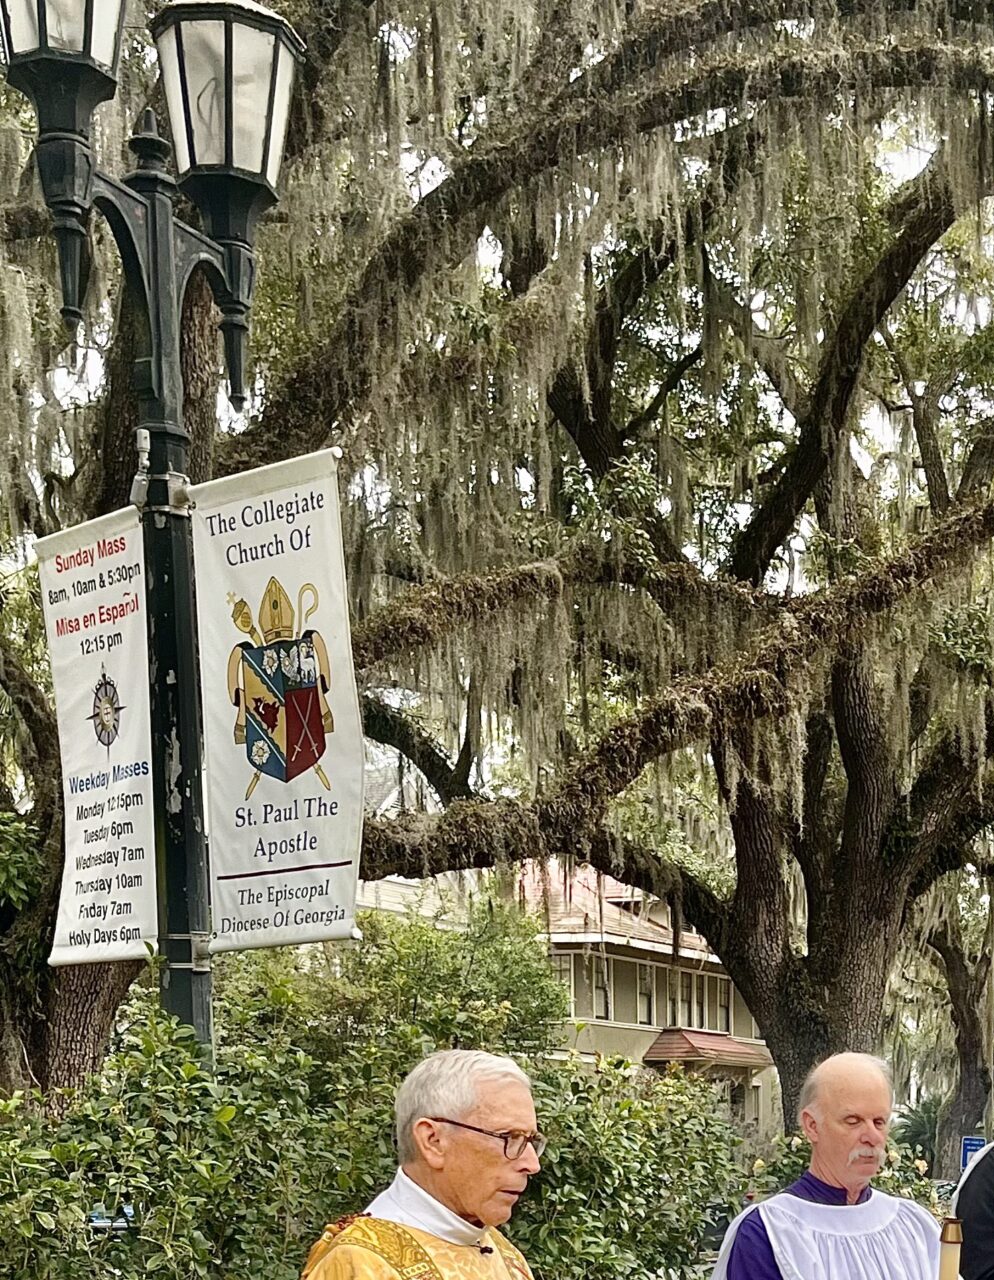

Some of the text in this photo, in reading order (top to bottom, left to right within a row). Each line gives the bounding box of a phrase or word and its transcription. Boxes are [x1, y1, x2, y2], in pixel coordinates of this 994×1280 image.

[206, 491, 324, 536] The Collegiate
[55, 536, 126, 573] Sunday Mass
[226, 525, 311, 566] Church Of
[48, 587, 70, 605] 8am,
[72, 578, 97, 597] 10am
[99, 572, 106, 588] &
[56, 592, 139, 637] Misa en Español
[80, 632, 123, 655] 12:15 pm
[69, 761, 149, 794] Weekday Masses
[76, 801, 105, 821] Monday
[235, 796, 338, 828] St. Paul The
[83, 821, 134, 844] Tuesday 6pm
[253, 830, 318, 862] Apostle
[75, 846, 145, 871] Wednesday 7am
[75, 873, 143, 896] Thursday 10am
[237, 879, 330, 907] The Episcopal
[78, 900, 132, 921] Friday 7am
[221, 905, 345, 934] Diocese Of Georgia
[69, 926, 140, 948] Holy Days 6pm
